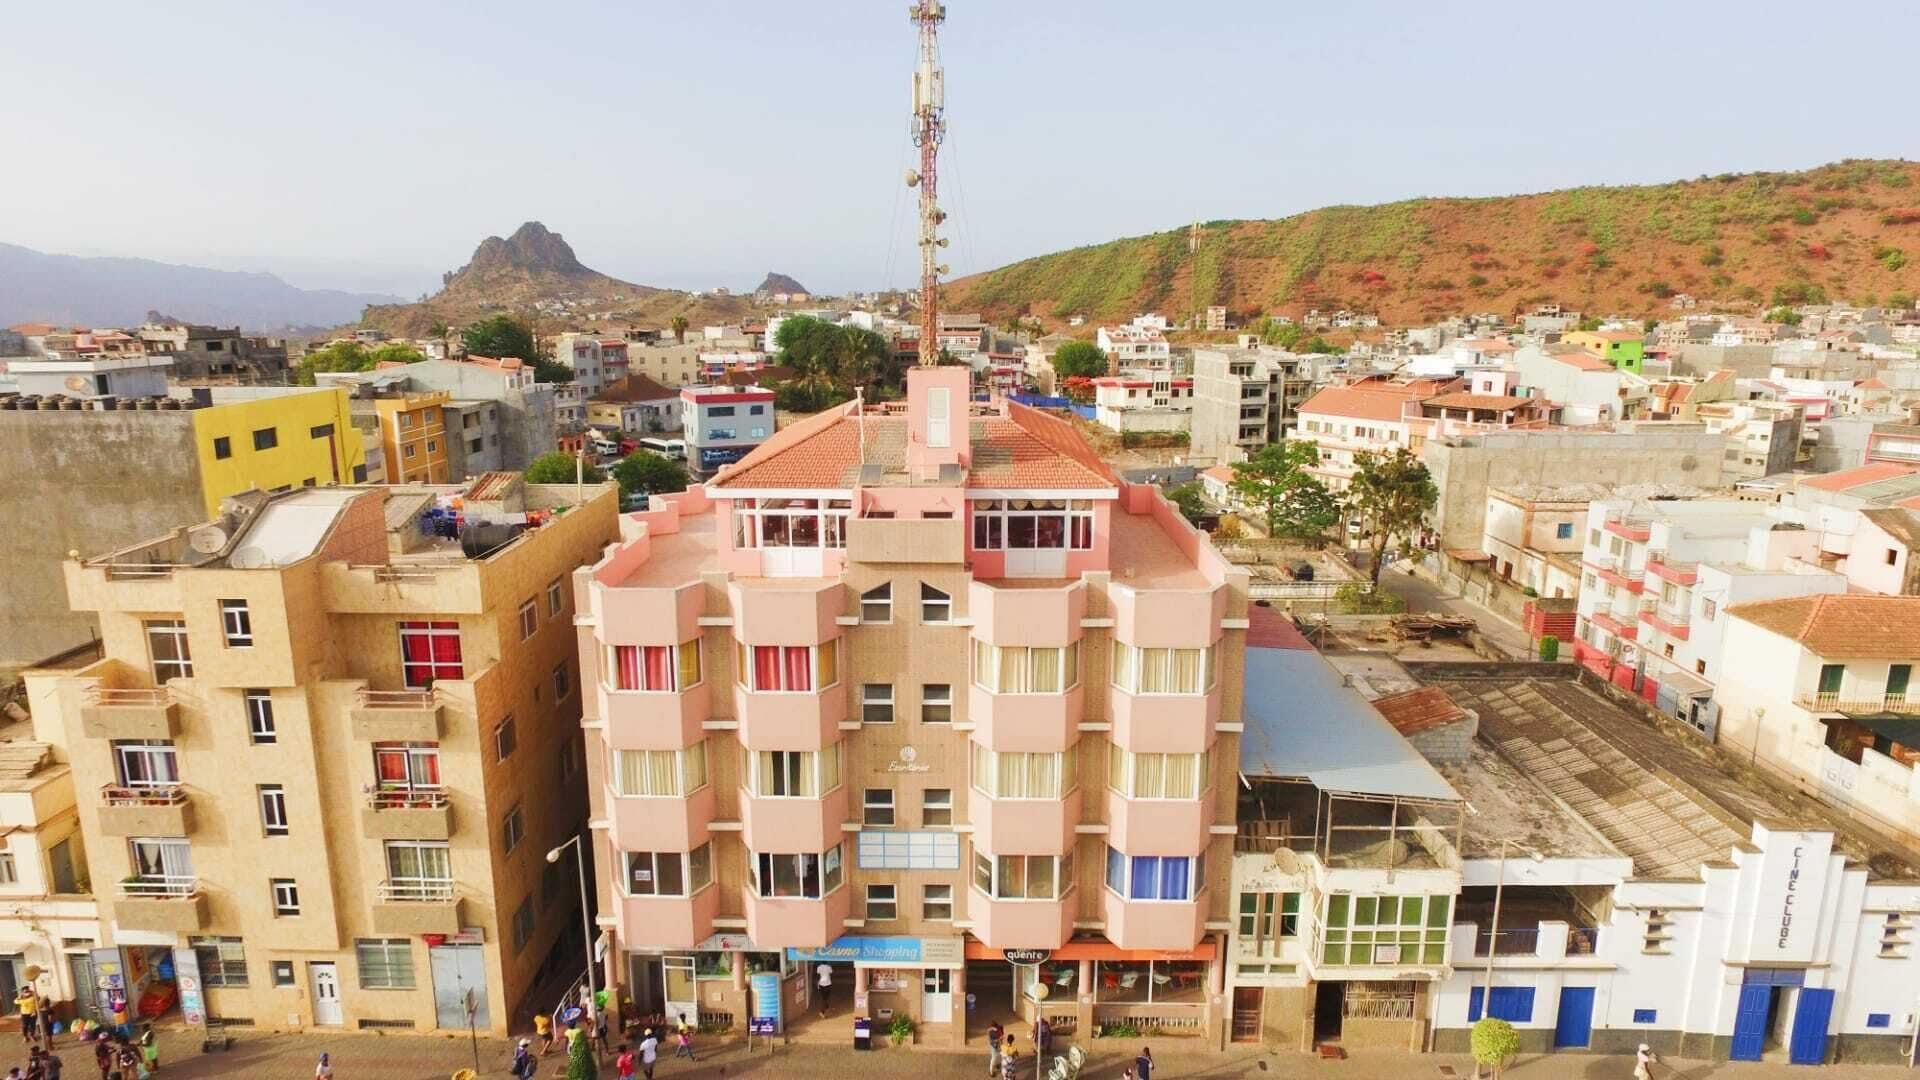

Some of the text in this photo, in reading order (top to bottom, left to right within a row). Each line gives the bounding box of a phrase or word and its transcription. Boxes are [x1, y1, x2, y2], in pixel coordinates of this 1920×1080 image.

[1778, 847, 1803, 949] CINE CLUBE
[862, 945, 917, 961] Shopping
[1007, 951, 1043, 961] quente
